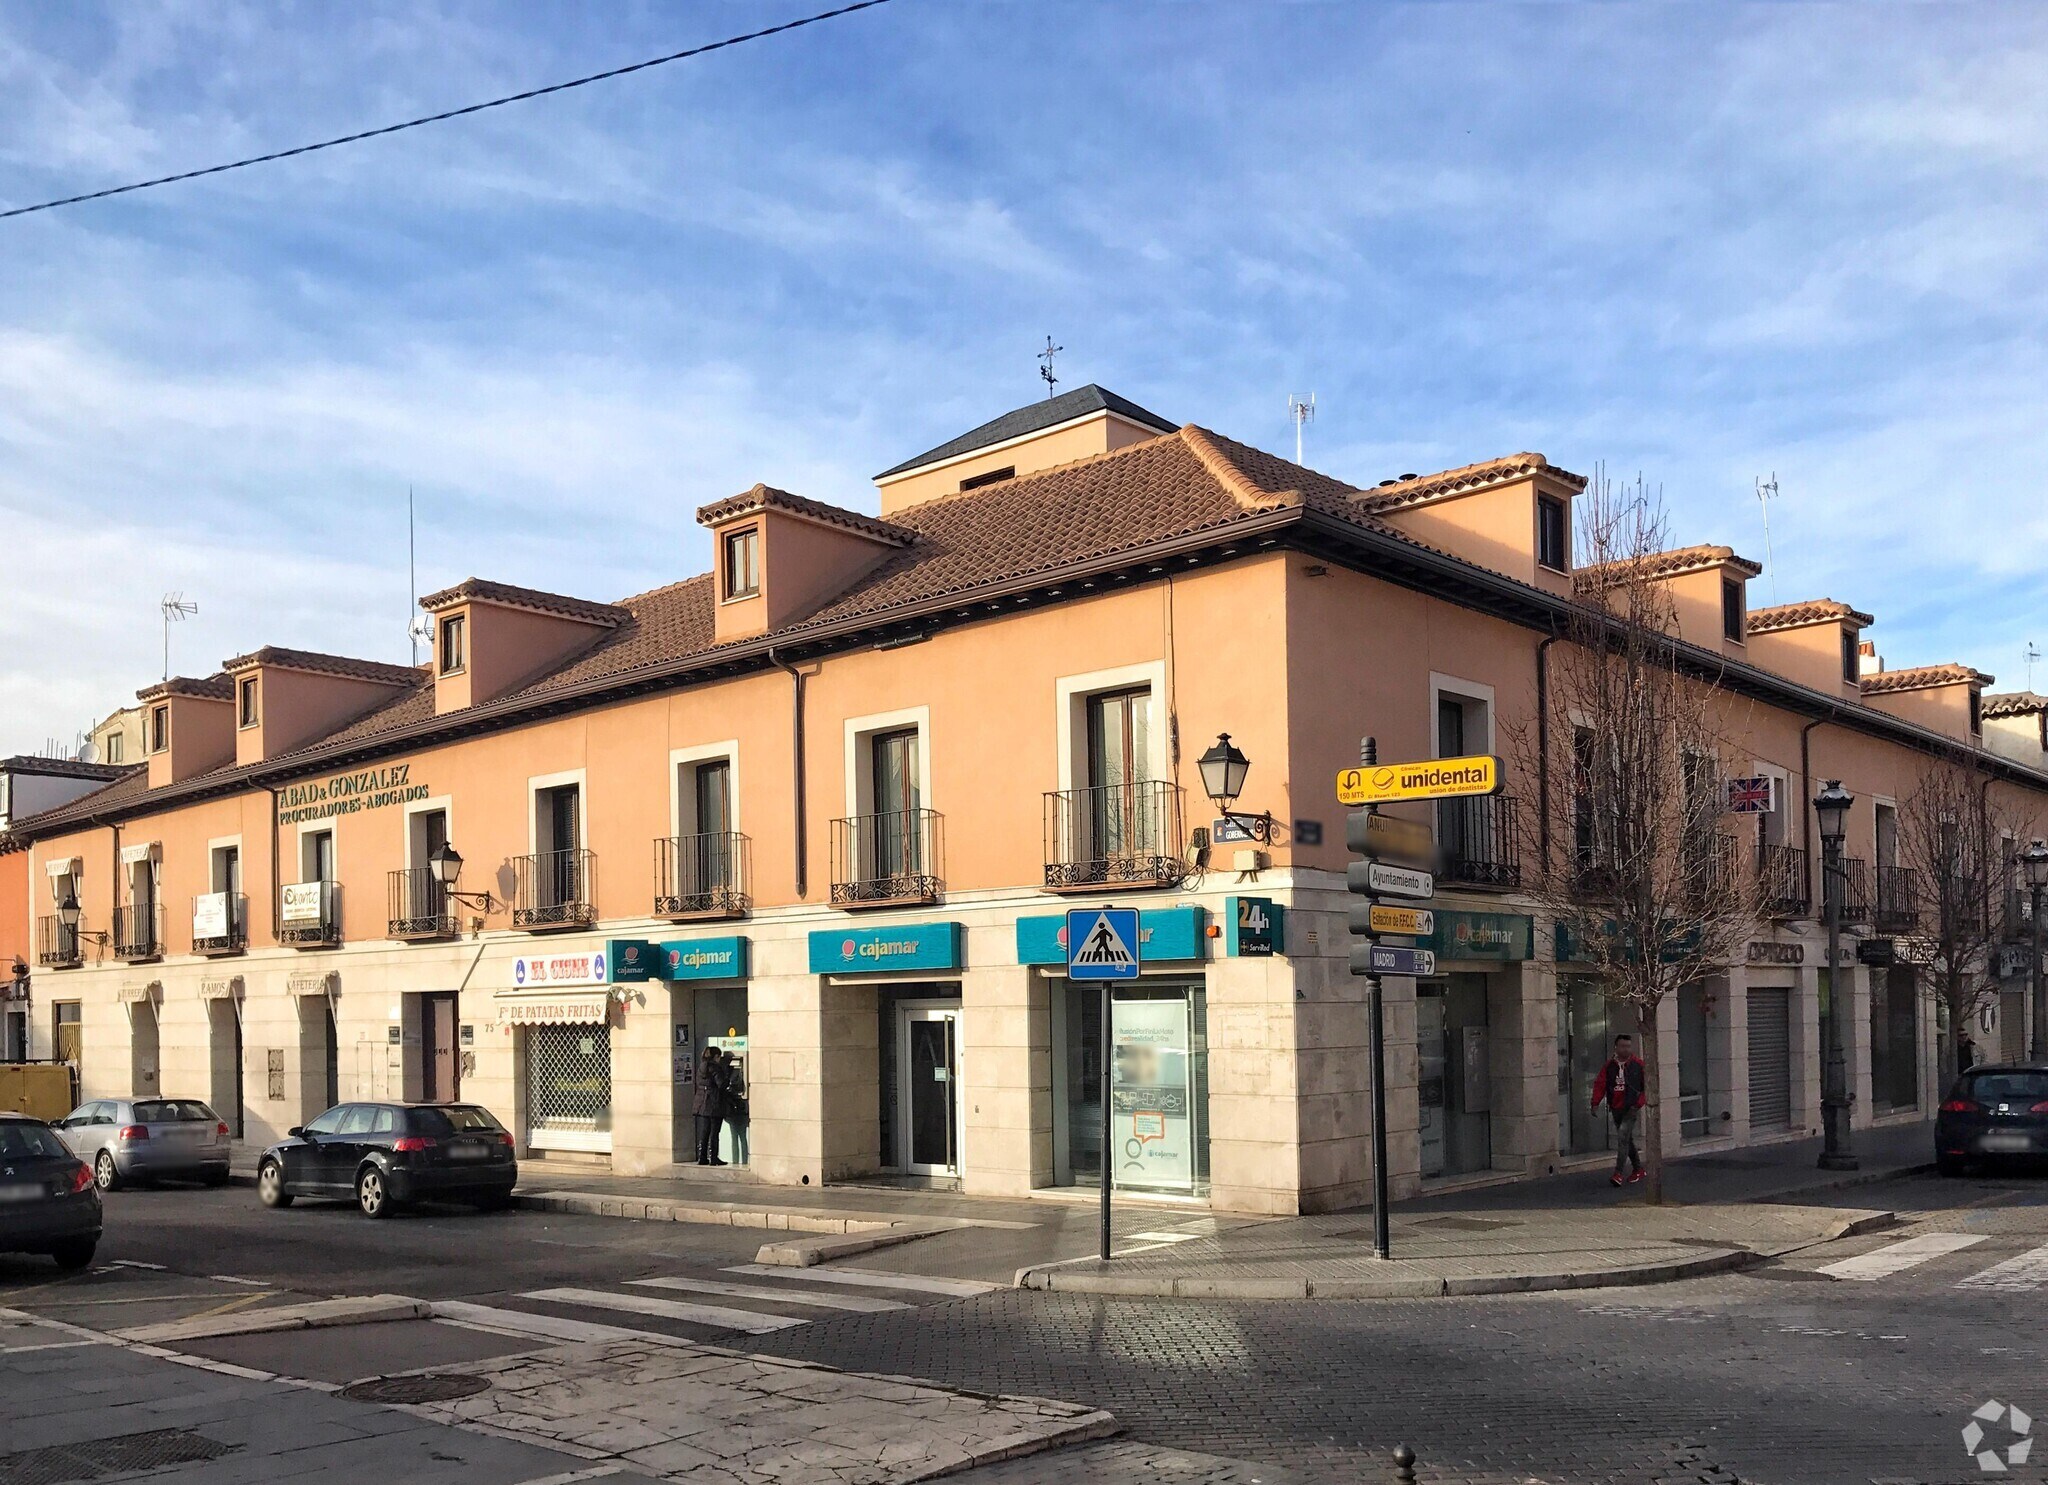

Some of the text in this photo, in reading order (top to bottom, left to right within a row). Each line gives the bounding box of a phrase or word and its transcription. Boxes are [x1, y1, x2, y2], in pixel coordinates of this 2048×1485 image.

[1401, 764, 1487, 788] unidental
[280, 783, 319, 808] ABAD
[328, 763, 410, 799] GONZALEZ
[1457, 784, 1487, 792] dentistas
[1339, 791, 1365, 800] 150 MTS
[1372, 869, 1419, 889] Ayuntamiento
[1393, 914, 1399, 927] de
[859, 938, 919, 961] cajamar
[683, 949, 733, 969] cajamar
[1373, 952, 1396, 967] MADRID
[530, 958, 590, 982] EL CISNE
[617, 966, 645, 976] cajamar
[201, 981, 226, 994] RAMOS
[511, 1007, 523, 1018] DE
[526, 1005, 565, 1018] PATATAS
[568, 1004, 602, 1017] FRITAS
[485, 1023, 495, 1033] 75
